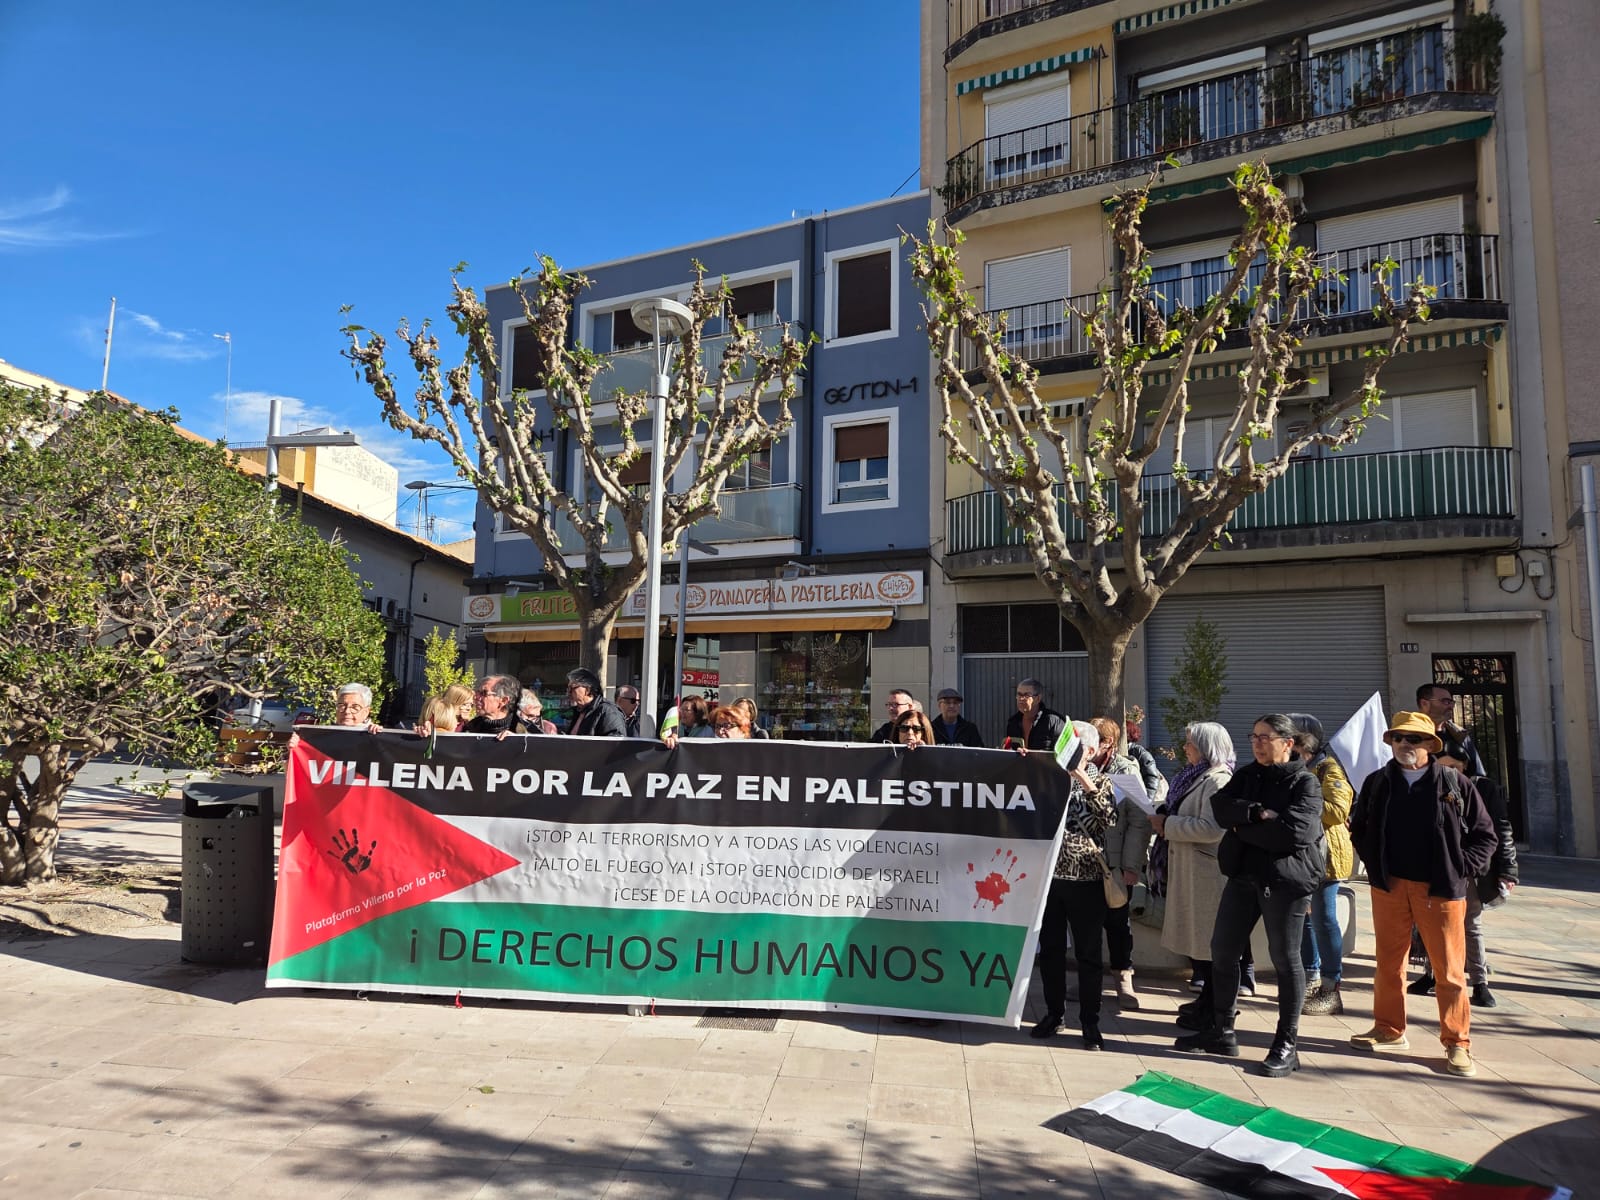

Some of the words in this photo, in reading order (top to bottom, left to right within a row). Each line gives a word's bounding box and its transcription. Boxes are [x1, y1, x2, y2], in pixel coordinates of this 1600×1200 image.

[308, 759, 473, 792] VILLENA
[486, 768, 570, 796] POR
[582, 771, 632, 798] LA
[646, 772, 722, 800] PAZ
[736, 776, 790, 802] EN
[805, 778, 1036, 811] PALESTINA
[526, 829, 572, 846] ¡STOP
[577, 831, 597, 846] AL
[602, 831, 709, 848] TERRORISMO
[714, 835, 723, 848] Y
[728, 836, 739, 849] A
[746, 836, 798, 851] TODAS
[804, 838, 832, 853] LAS
[836, 838, 940, 857] VIOLENCIAS!
[533, 857, 579, 873] ¡ALTO
[585, 858, 602, 873] EL
[607, 859, 663, 875] FUEGO
[666, 859, 694, 876] YA!
[700, 863, 747, 879] ¡STOP
[752, 864, 847, 881] GENOCIDIO
[852, 867, 873, 882] DE
[879, 868, 939, 885] ISRAEL!
[305, 903, 361, 934] Plataforma
[362, 889, 395, 910] Villena
[396, 881, 414, 898] por
[416, 876, 427, 888] la
[614, 887, 658, 903] ¡CESE
[665, 889, 686, 904] DE
[691, 890, 711, 904] LA
[715, 887, 813, 908] OCUPACIÓN
[819, 894, 840, 908] DE
[846, 895, 940, 913] PALESTINA!
[438, 928, 678, 973] DERECHOS
[695, 938, 945, 984] HUMANOS
[959, 949, 1013, 991] YA
